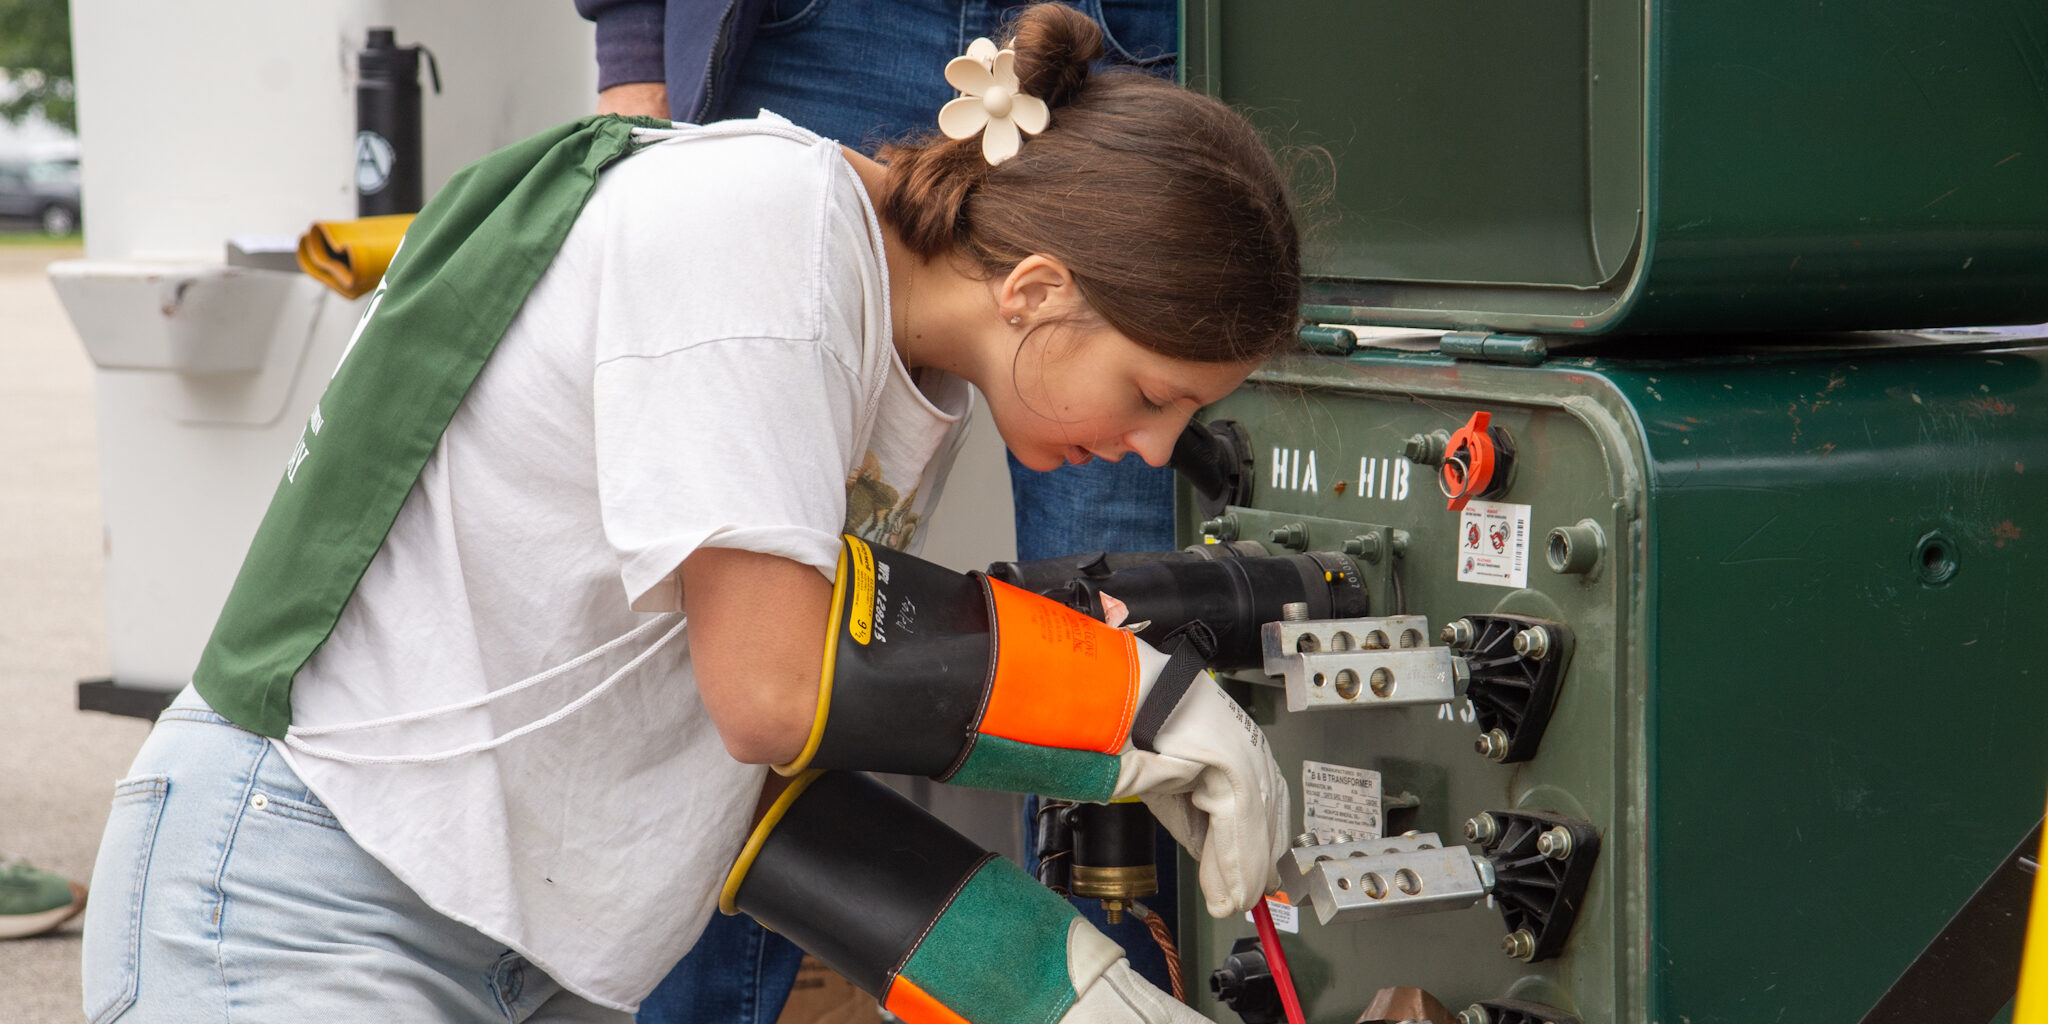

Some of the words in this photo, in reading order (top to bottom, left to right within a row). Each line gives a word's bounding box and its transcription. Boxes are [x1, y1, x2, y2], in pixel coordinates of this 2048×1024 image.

[877, 561, 890, 585] WPL
[857, 618, 868, 630] 9
[874, 589, 888, 643] 128615
[1327, 774, 1373, 788] TRANSFORMER
